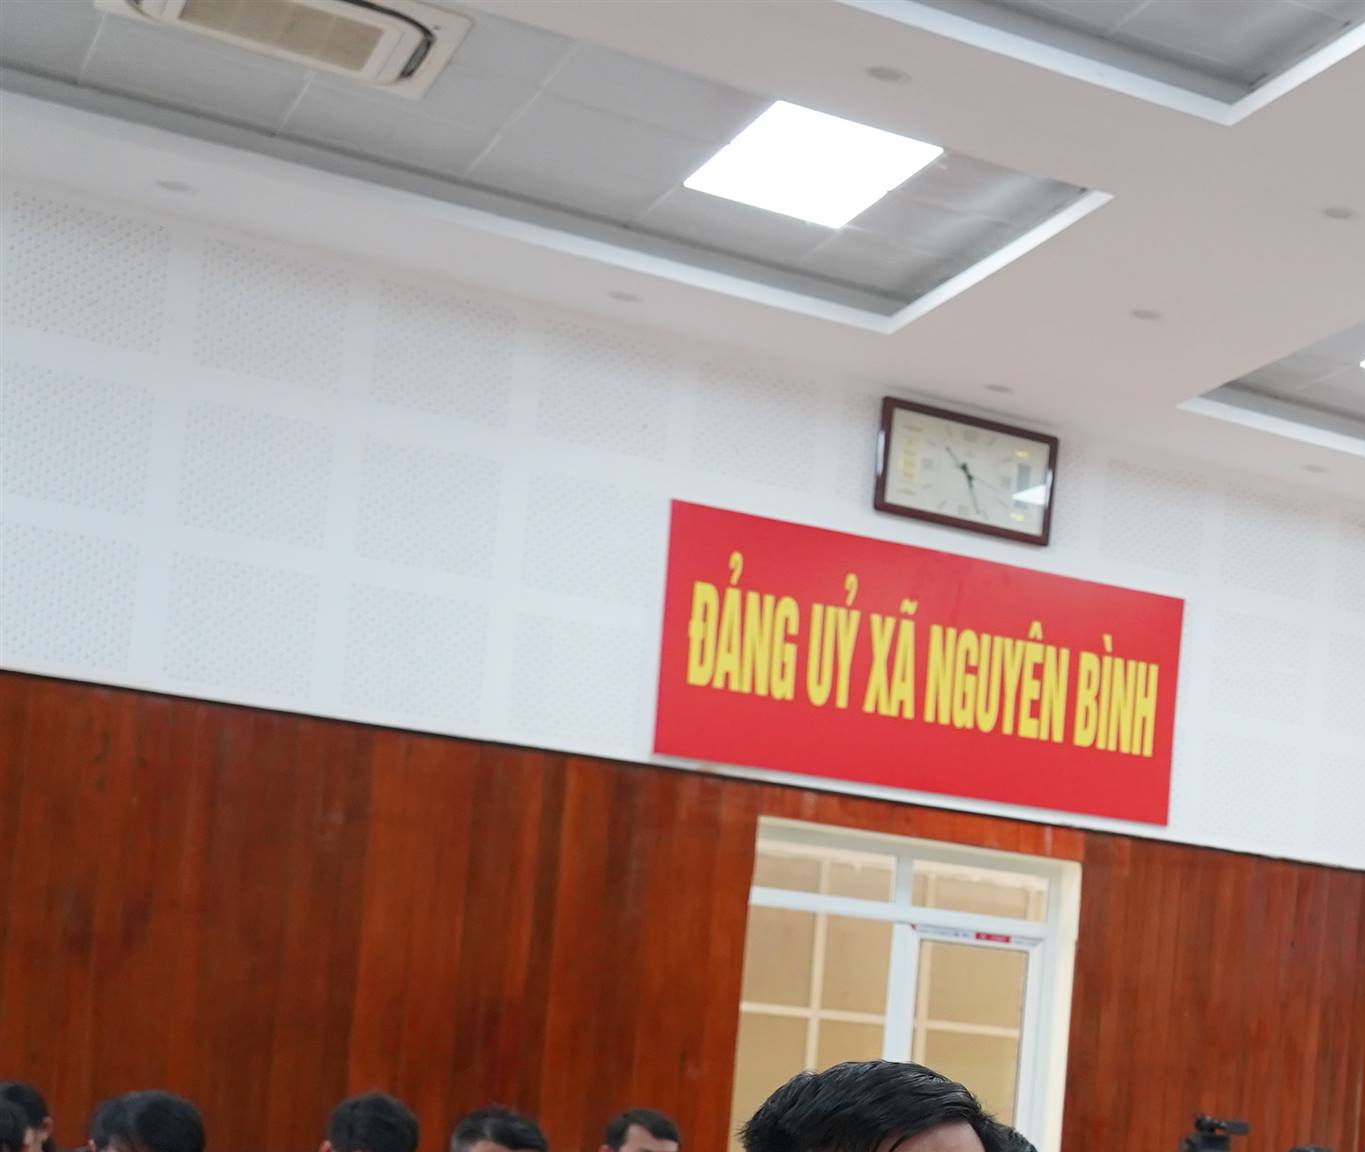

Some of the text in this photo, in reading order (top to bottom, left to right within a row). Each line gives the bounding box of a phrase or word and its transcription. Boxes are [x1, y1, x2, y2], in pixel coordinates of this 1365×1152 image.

[686, 551, 1160, 758] ĐẢNG UỶ XÃ NGUYÊN BÌNH
